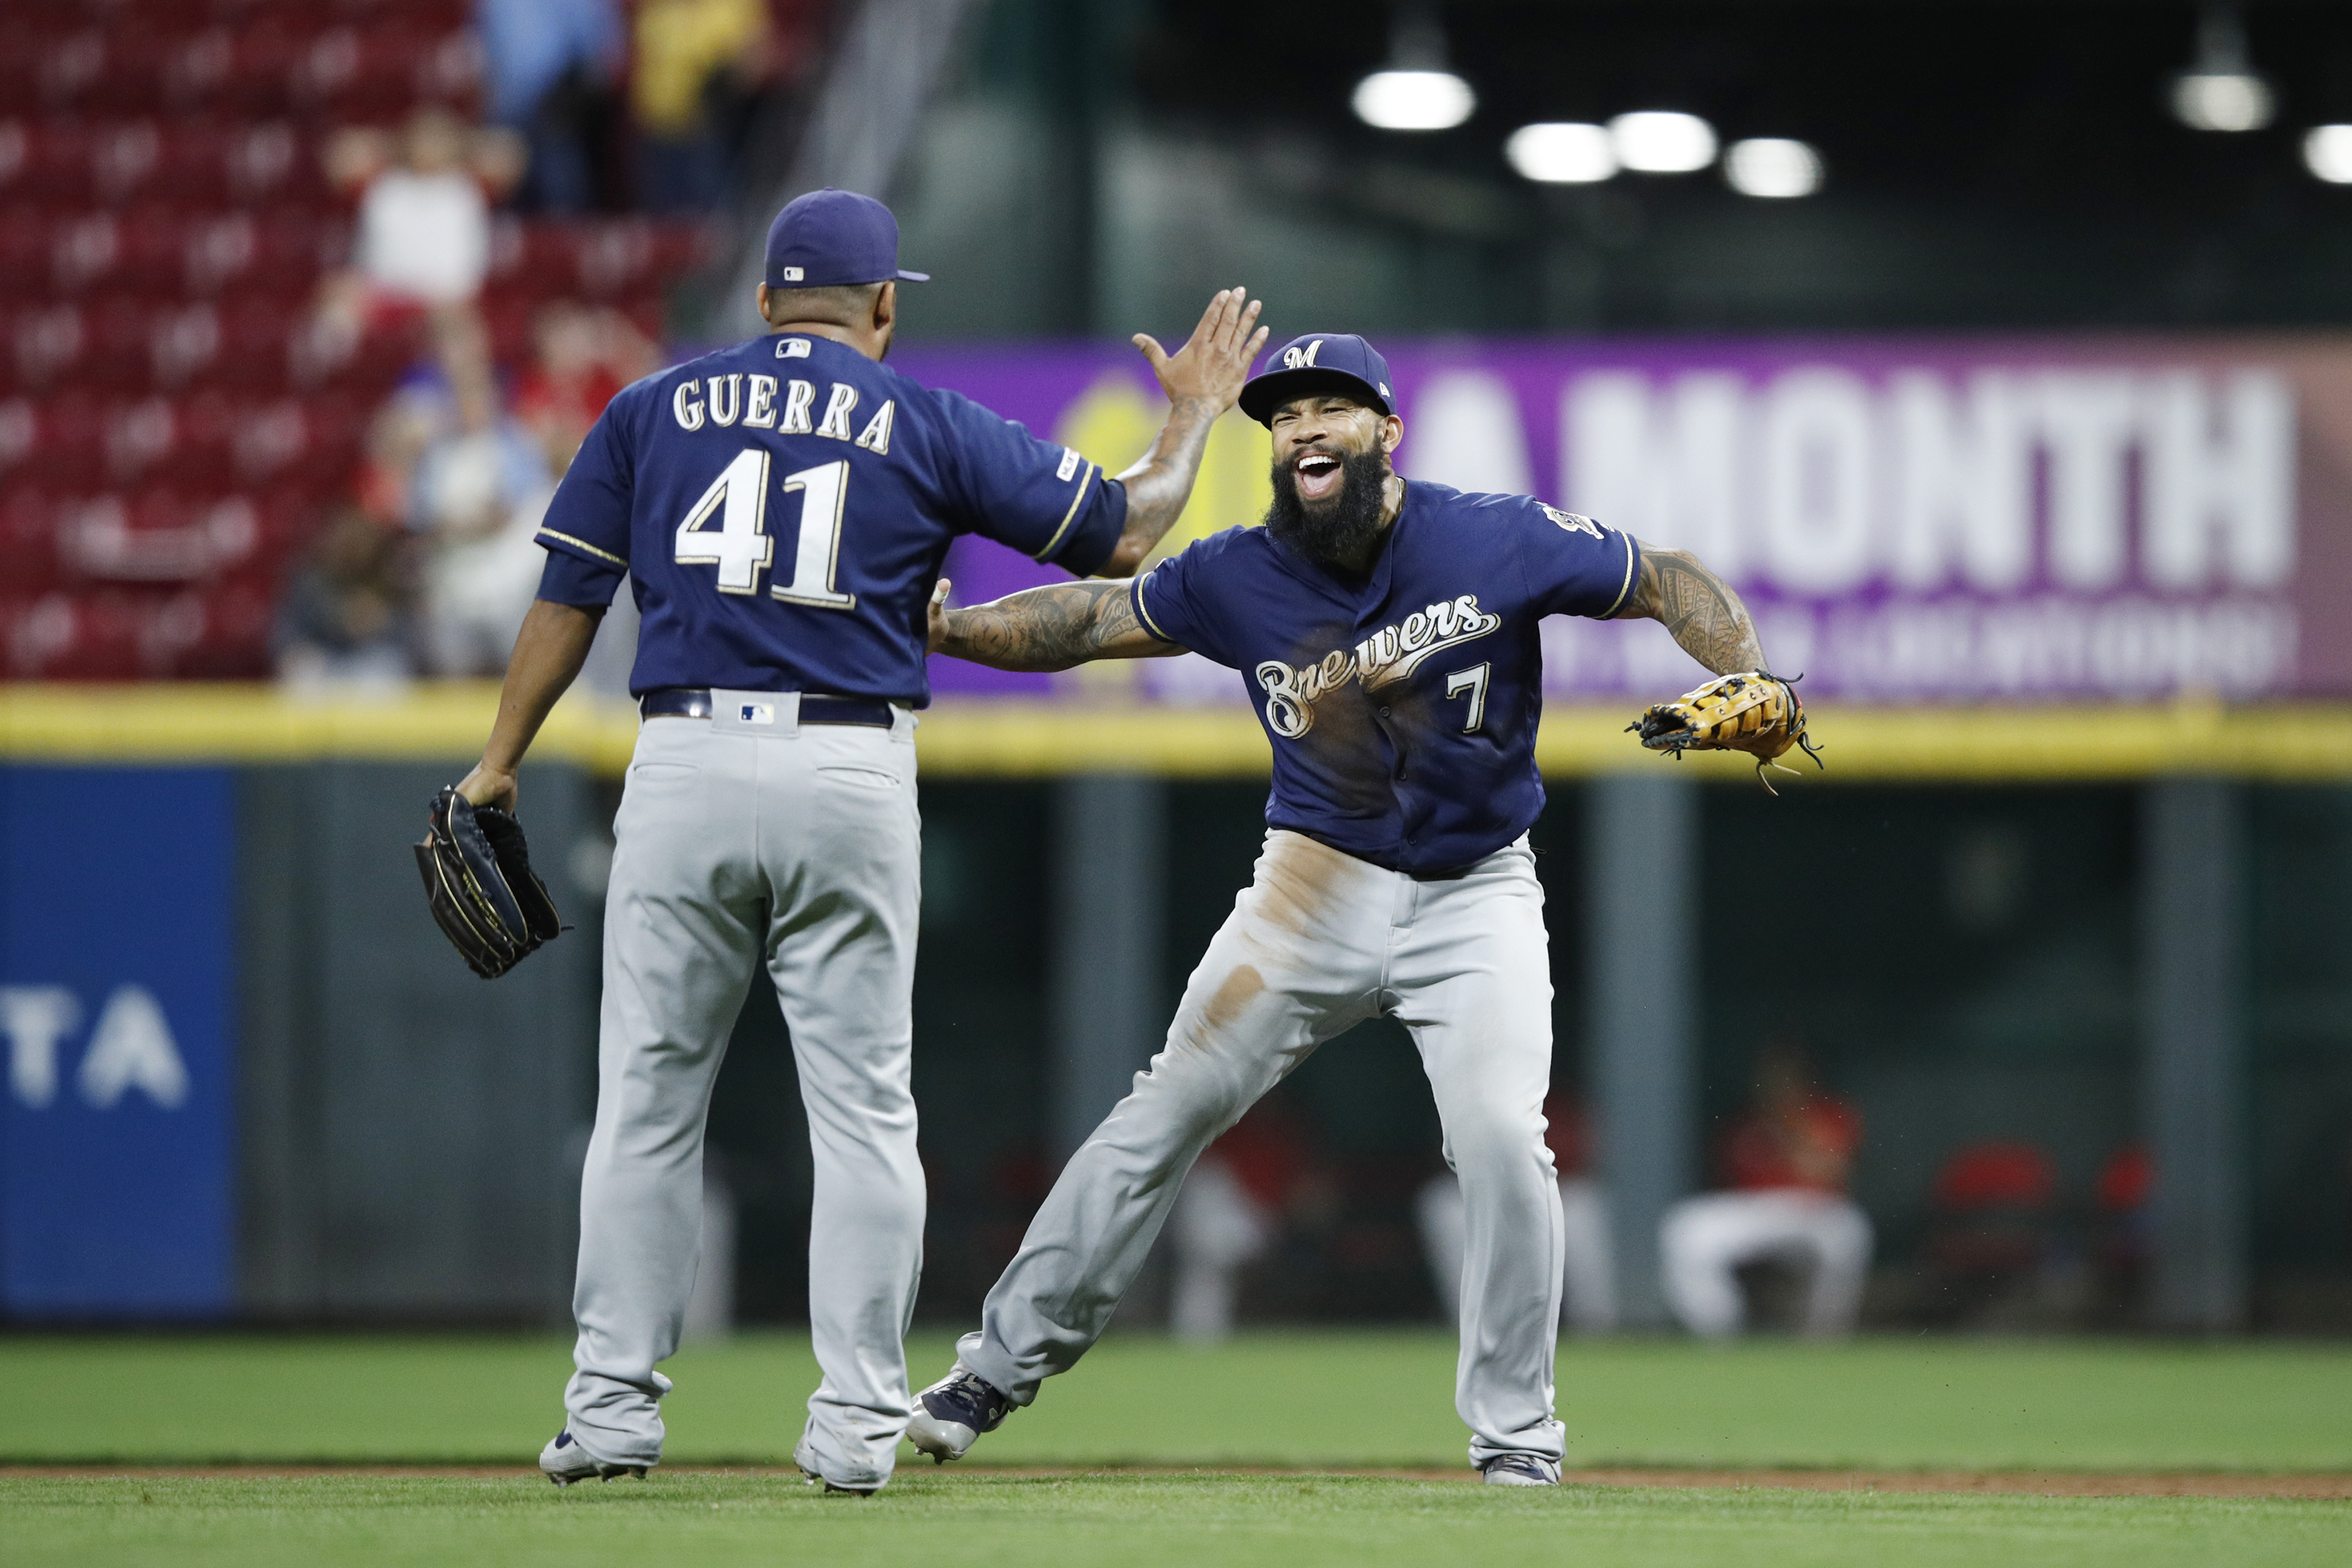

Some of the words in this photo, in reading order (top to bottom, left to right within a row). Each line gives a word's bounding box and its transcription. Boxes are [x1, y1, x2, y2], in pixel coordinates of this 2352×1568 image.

[673, 373, 895, 455] GUERRA
[1283, 339, 1324, 369] M
[675, 448, 855, 610] 41
[1562, 369, 2294, 593] MONTH
[1255, 594, 1501, 739] Brewers
[1446, 661, 1491, 734] 7
[0, 985, 190, 1109] TA
